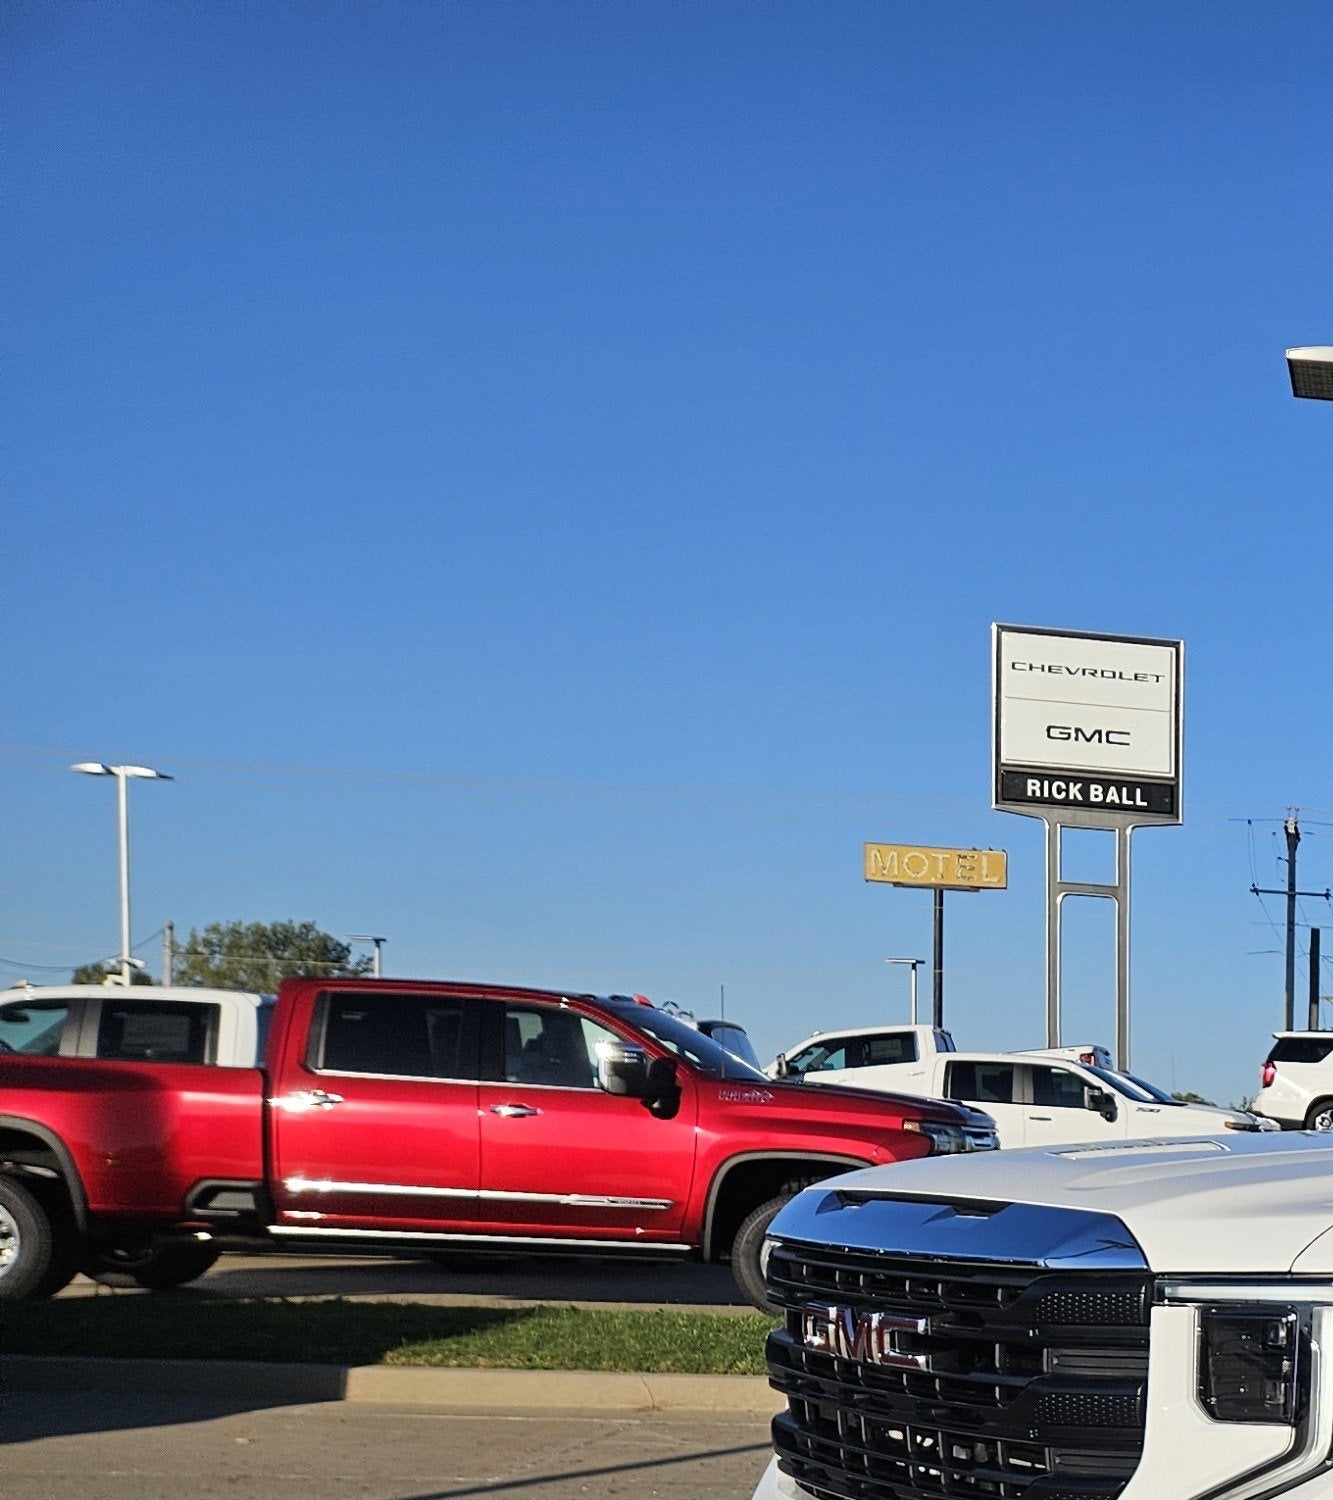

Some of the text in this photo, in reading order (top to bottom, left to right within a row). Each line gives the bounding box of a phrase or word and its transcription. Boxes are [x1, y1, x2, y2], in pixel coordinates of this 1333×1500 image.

[1011, 661, 1165, 683] CHEVROLET
[1046, 725, 1131, 746] GMC
[1027, 779, 1148, 807] RICK BALL
[870, 850, 1001, 883] MOTEL
[802, 1302, 927, 1372] GMC
